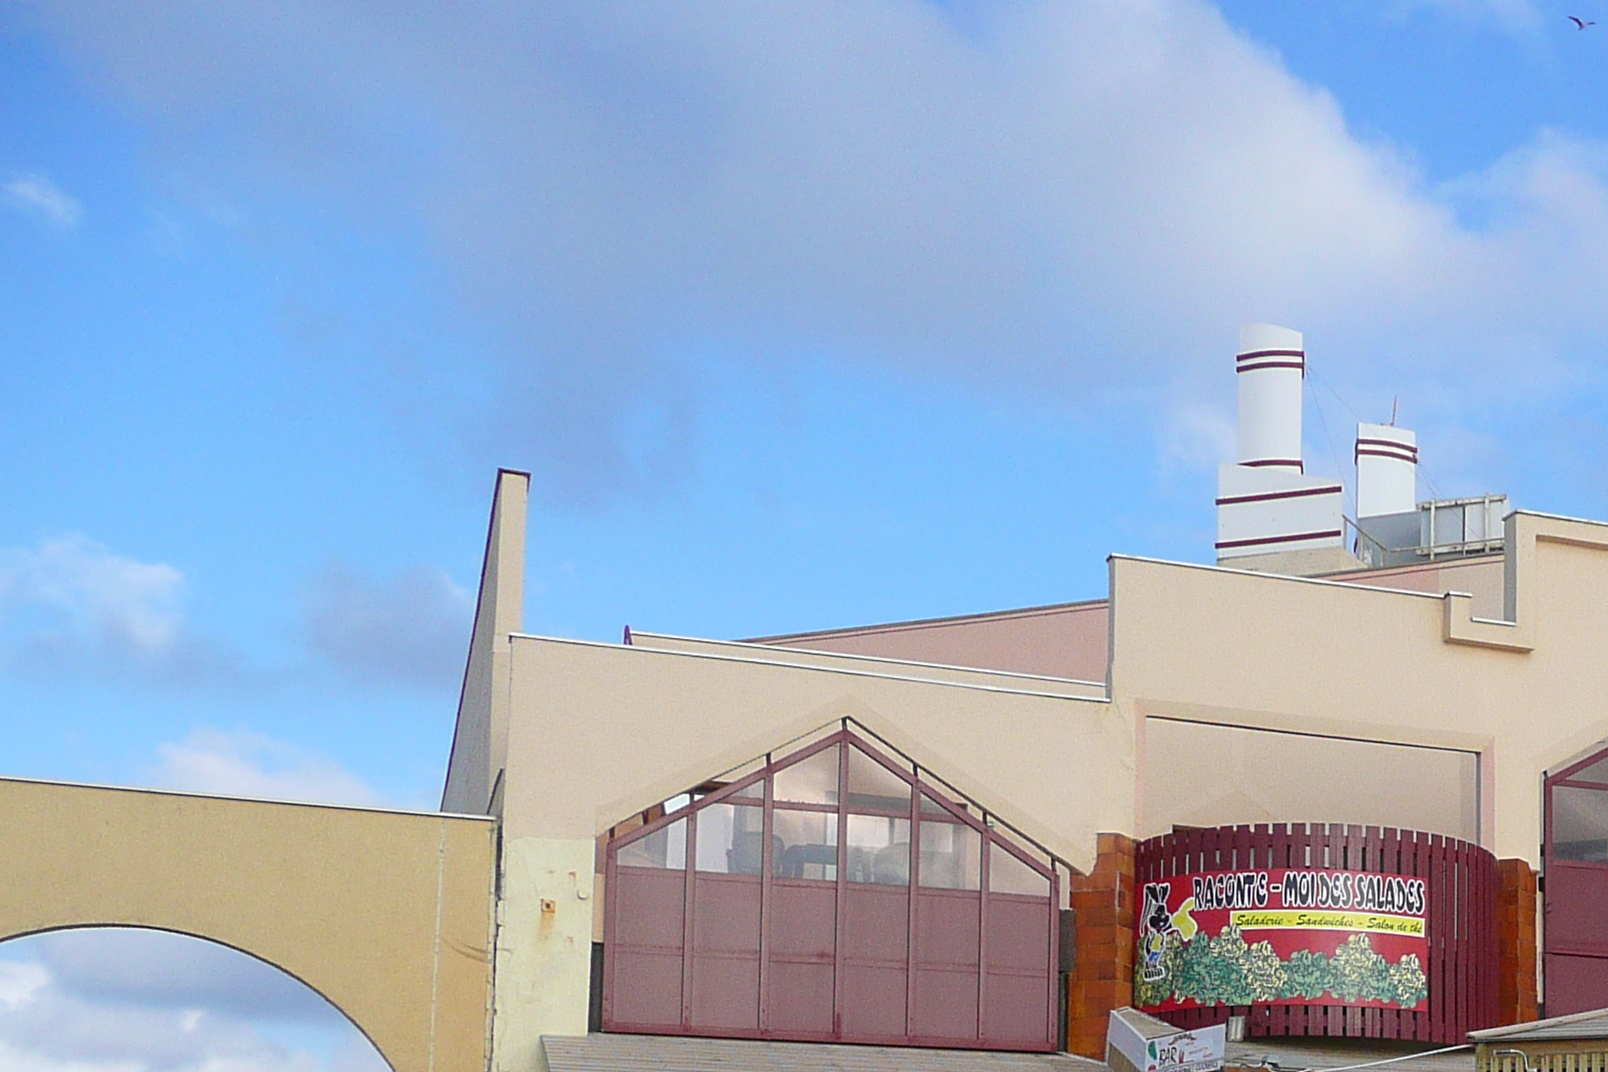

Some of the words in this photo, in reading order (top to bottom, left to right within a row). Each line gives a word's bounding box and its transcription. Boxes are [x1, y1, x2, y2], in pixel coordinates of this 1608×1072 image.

[1193, 871, 1268, 911] RACONTE
[1317, 872, 1353, 908] DES
[1354, 874, 1425, 915] SALADES
[1236, 914, 1283, 926] Saladerie
[1366, 917, 1394, 929] Salon
[1397, 922, 1407, 932] de
